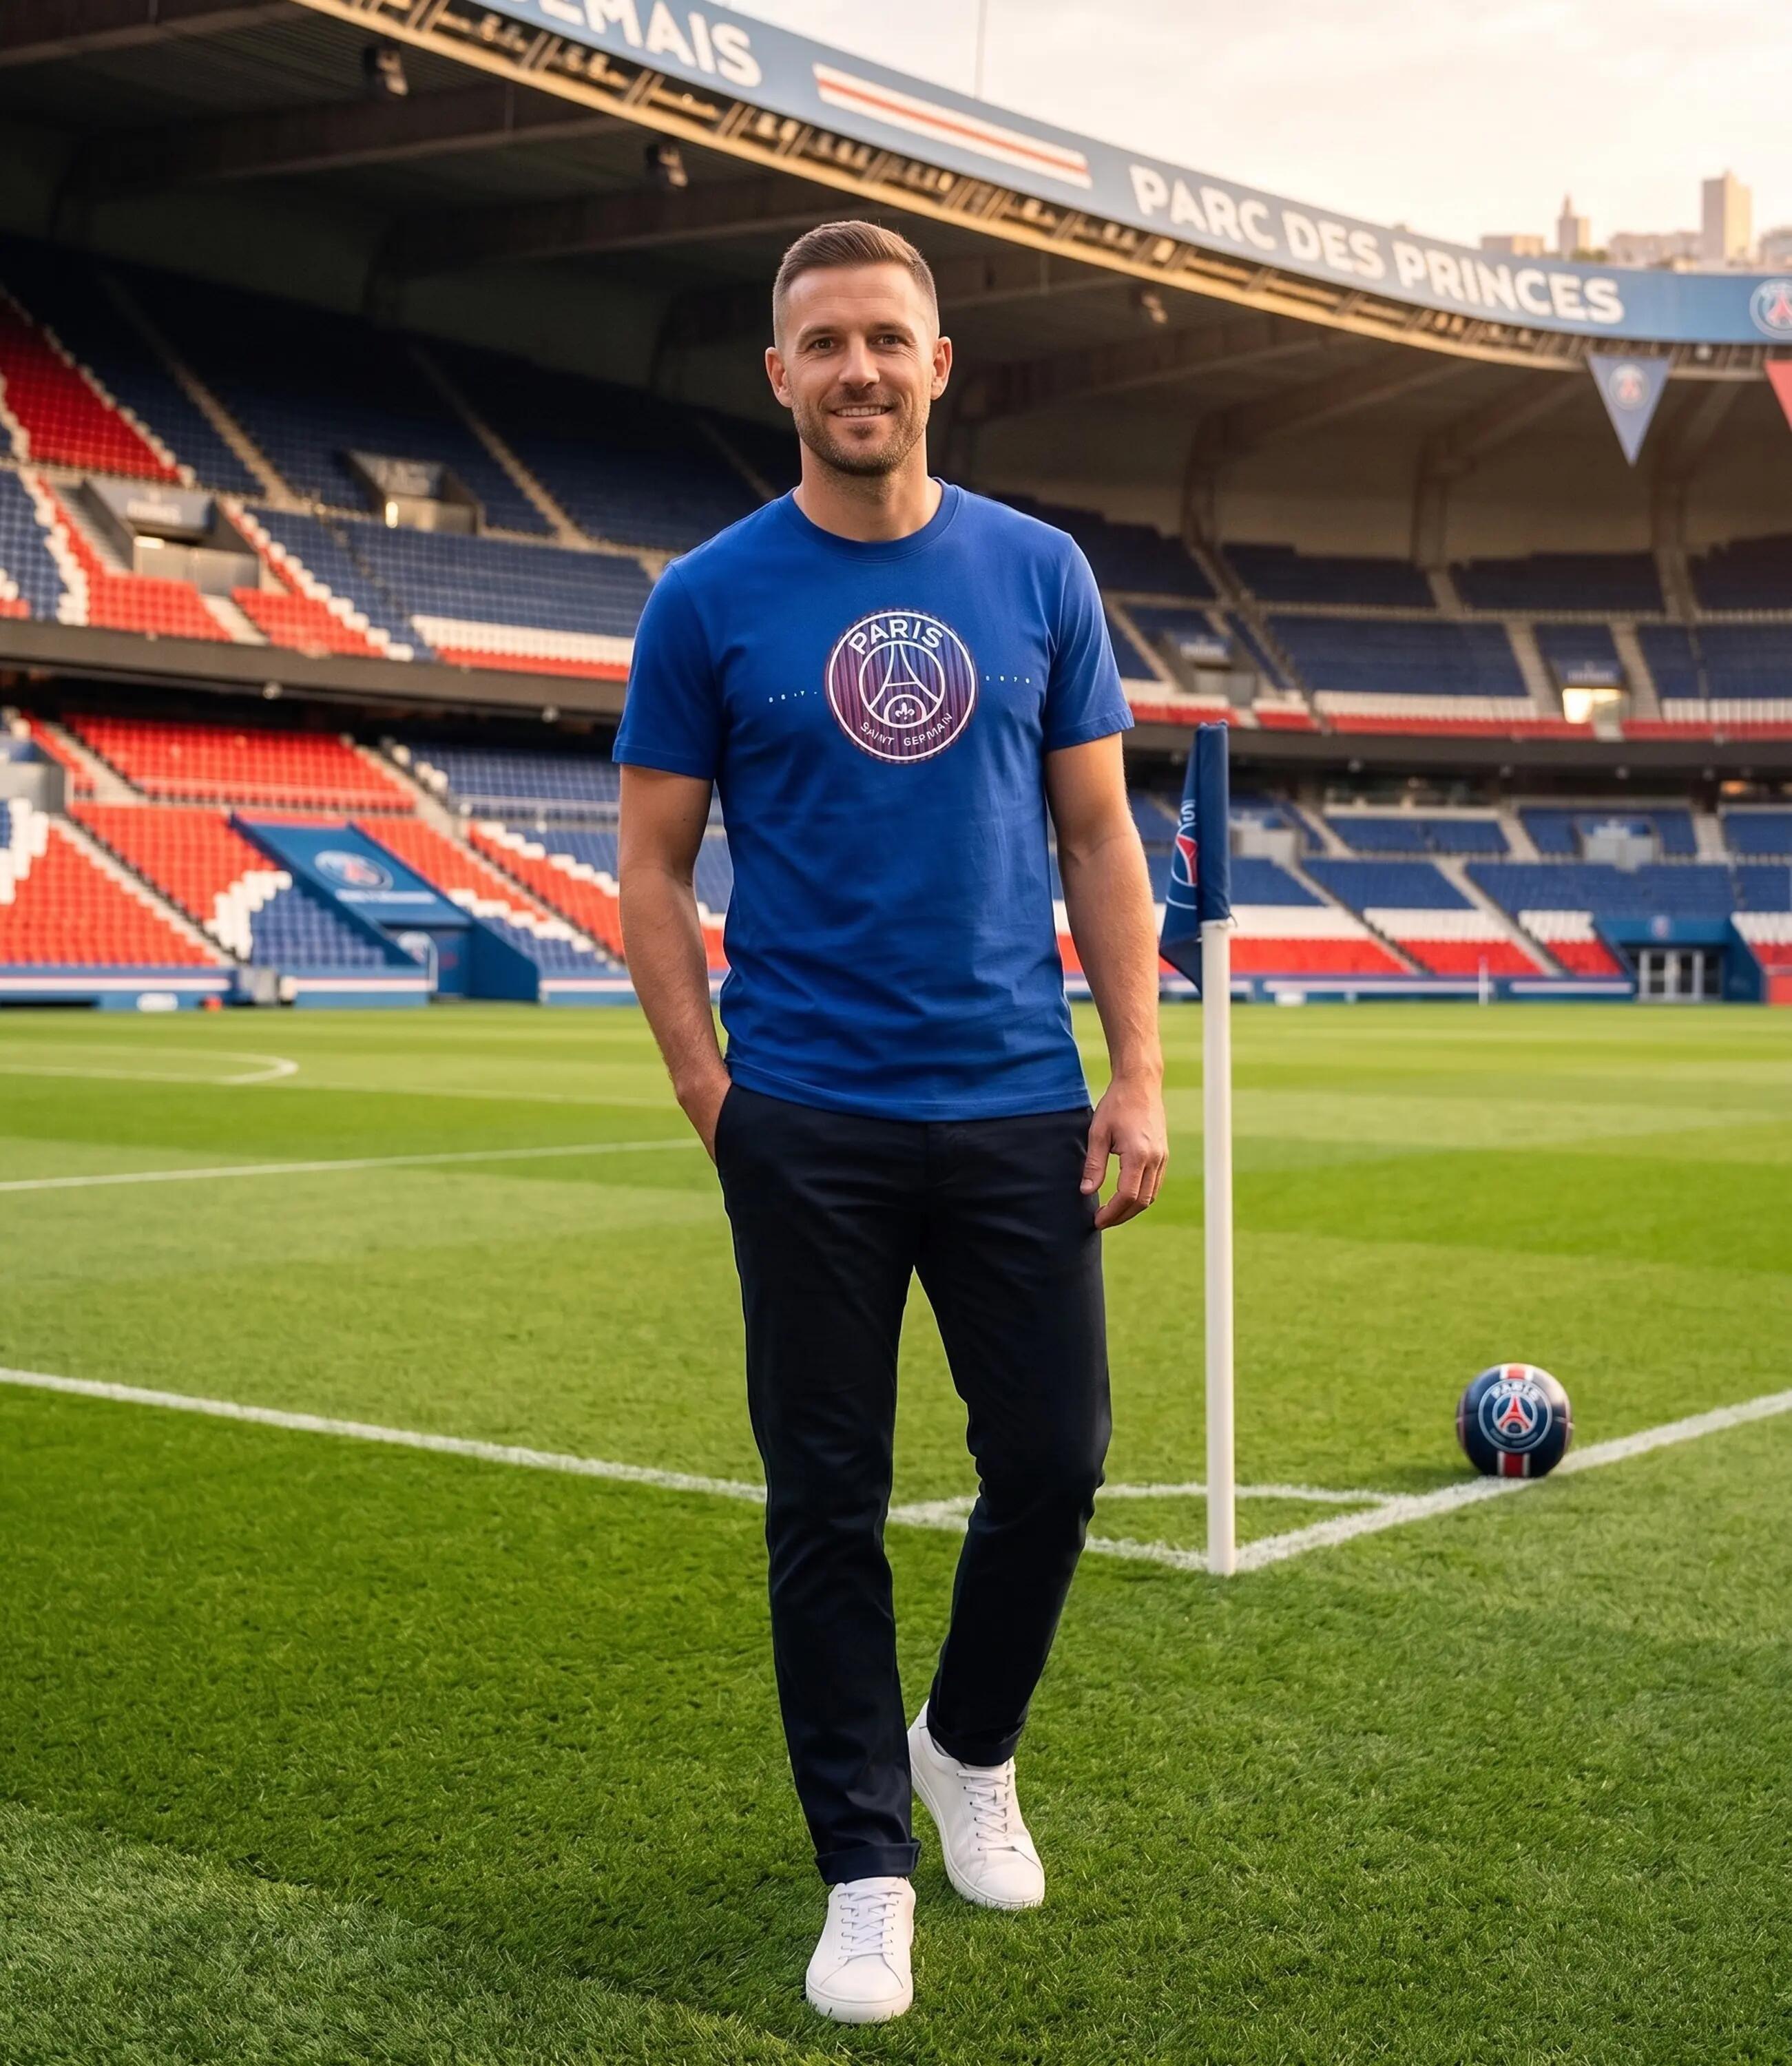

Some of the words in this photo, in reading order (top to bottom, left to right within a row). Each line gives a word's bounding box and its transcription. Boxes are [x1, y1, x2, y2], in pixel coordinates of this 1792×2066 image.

[1129, 164, 1276, 251] PARC
[1281, 209, 1386, 280] DES
[1392, 240, 1625, 324] PRINCES
[848, 619, 943, 655] PARIS
[861, 722, 895, 745] SAINT
[904, 713, 952, 746] GERMAIN
